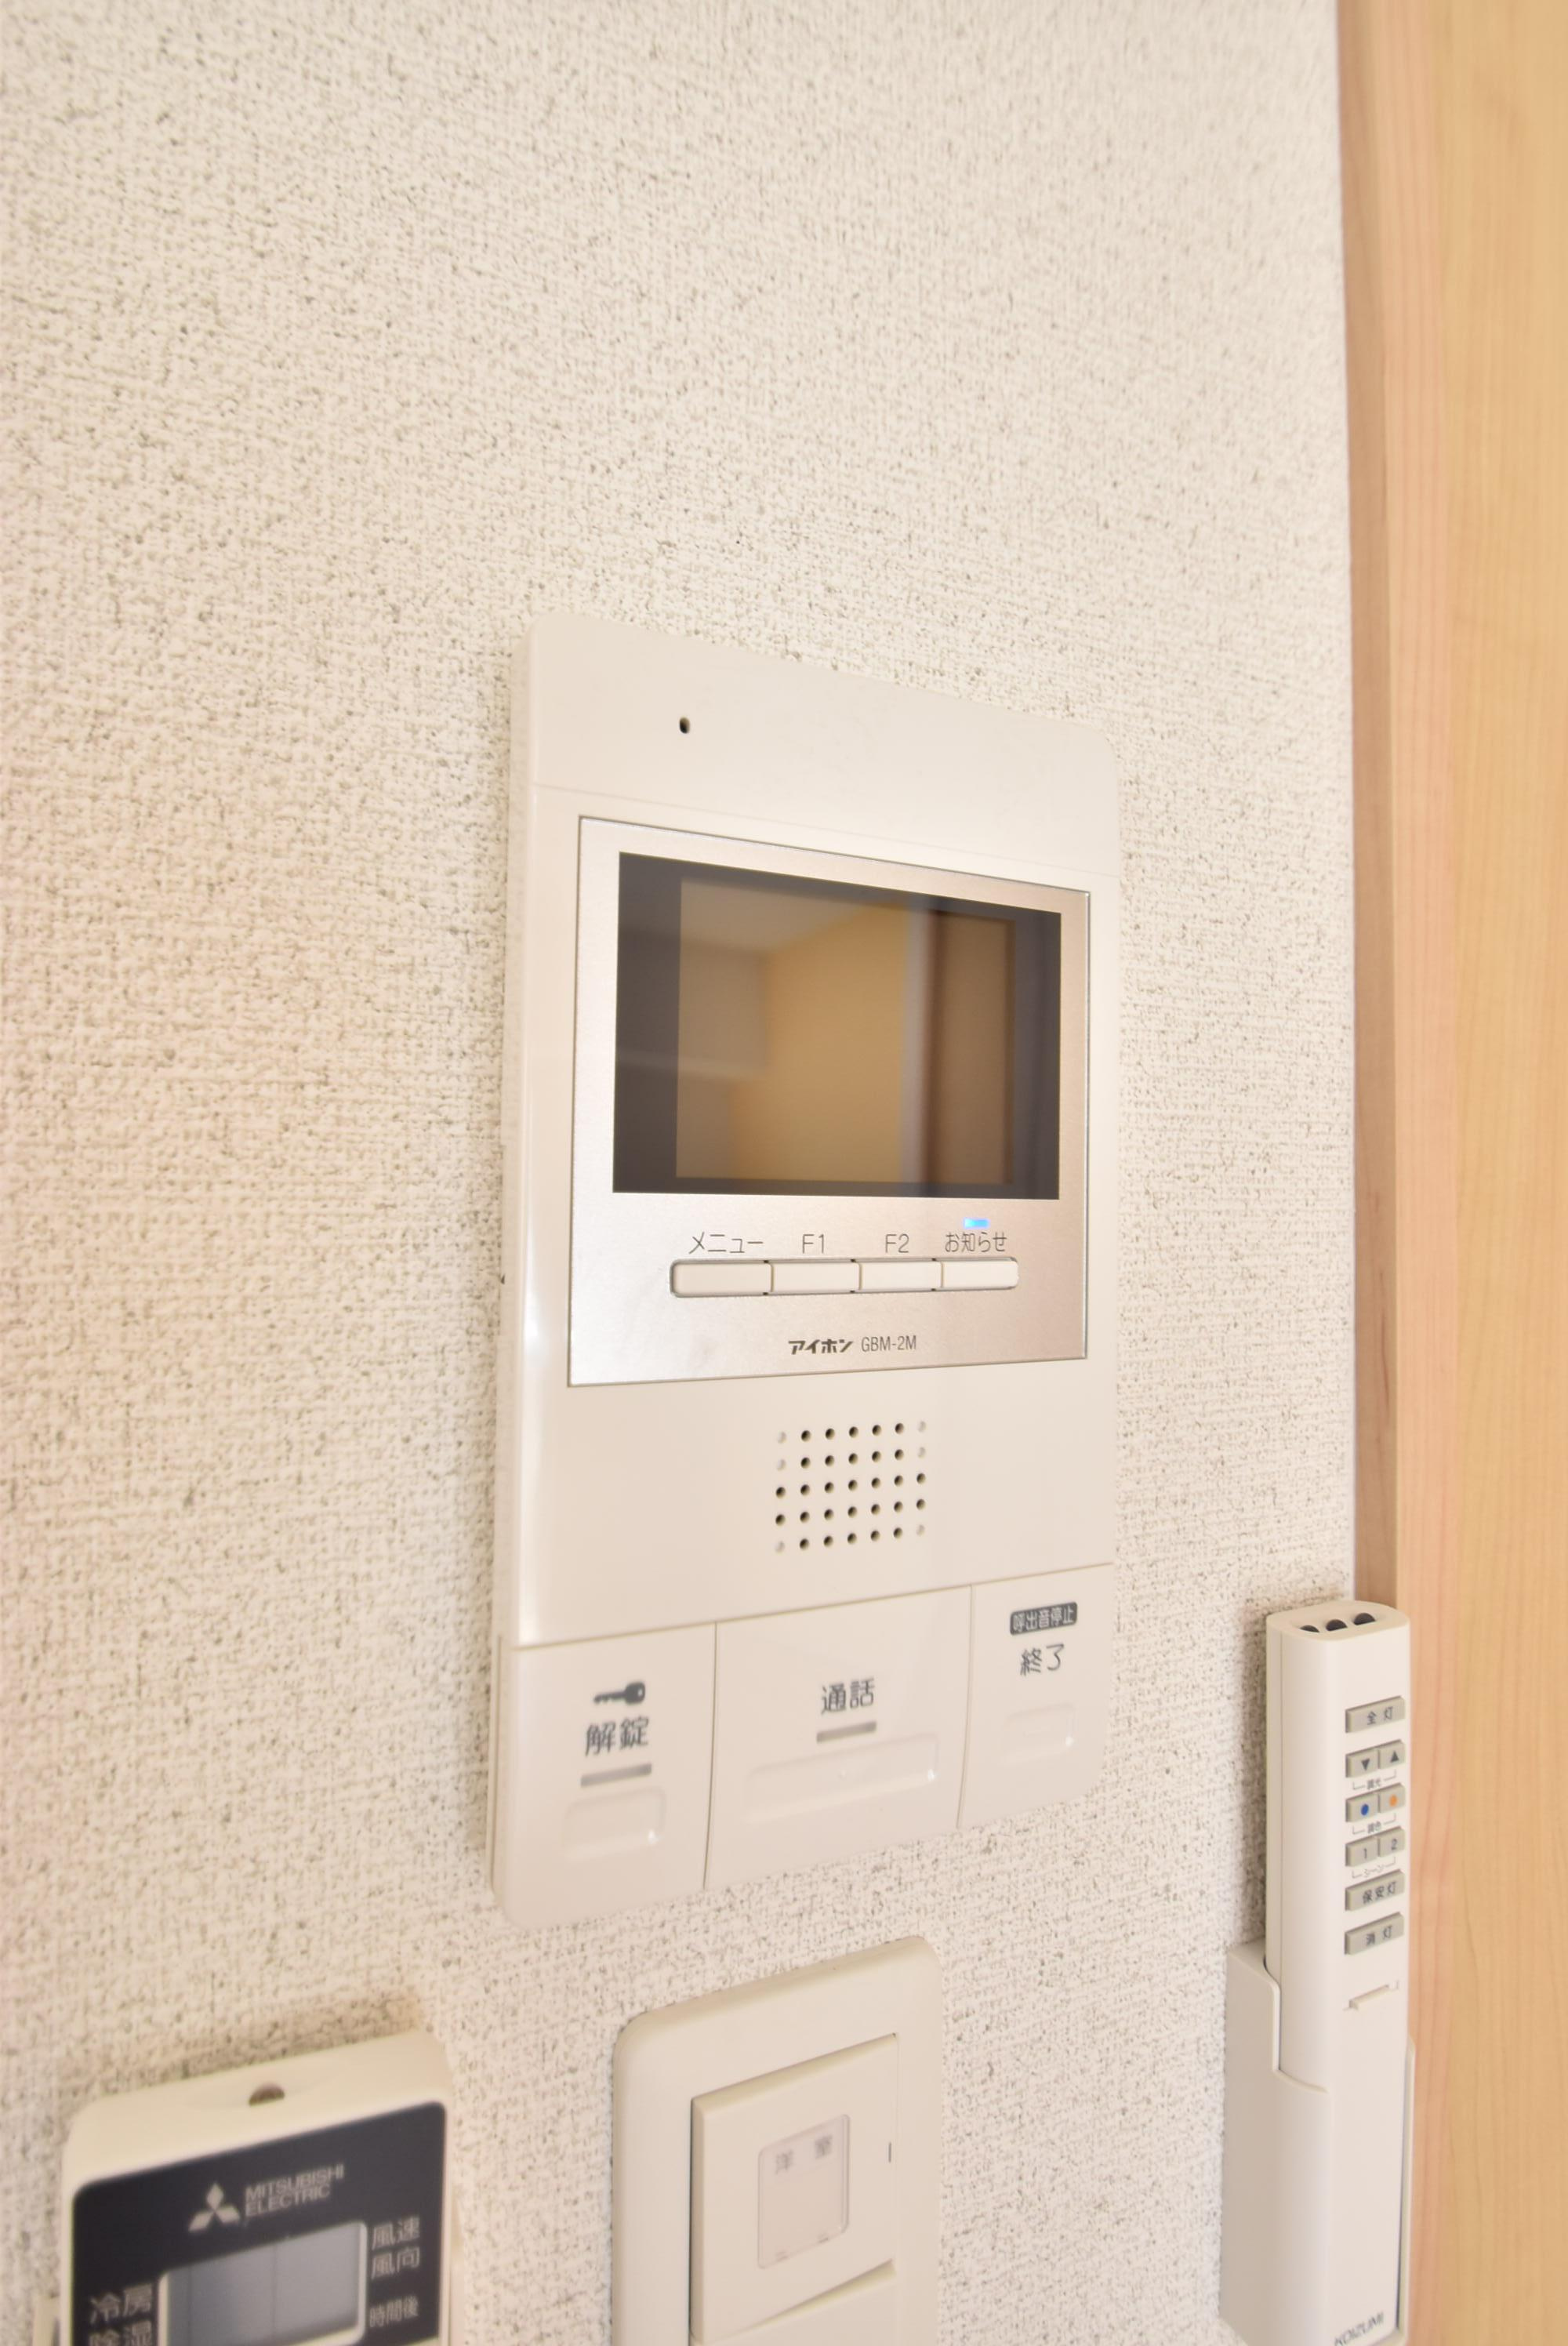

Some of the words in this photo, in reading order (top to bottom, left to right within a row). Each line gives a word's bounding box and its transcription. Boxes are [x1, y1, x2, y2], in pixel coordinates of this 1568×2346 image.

[688, 1231, 764, 1255] メニュー
[802, 1233, 826, 1254] F1
[884, 1233, 910, 1254] F2
[944, 1231, 1008, 1254] お知らせ
[787, 1338, 855, 1356] アイホン
[861, 1335, 917, 1353] GBM-2M
[1019, 1643, 1065, 1676] 終了
[819, 1676, 876, 1716] 通話
[584, 1716, 651, 1756] 解錠
[245, 2163, 345, 2203] MITSUBISHI
[245, 2183, 332, 2218] ELECTRIC
[371, 2215, 421, 2251] 風速
[370, 2246, 421, 2280] 風向
[89, 2282, 152, 2325] 冷房
